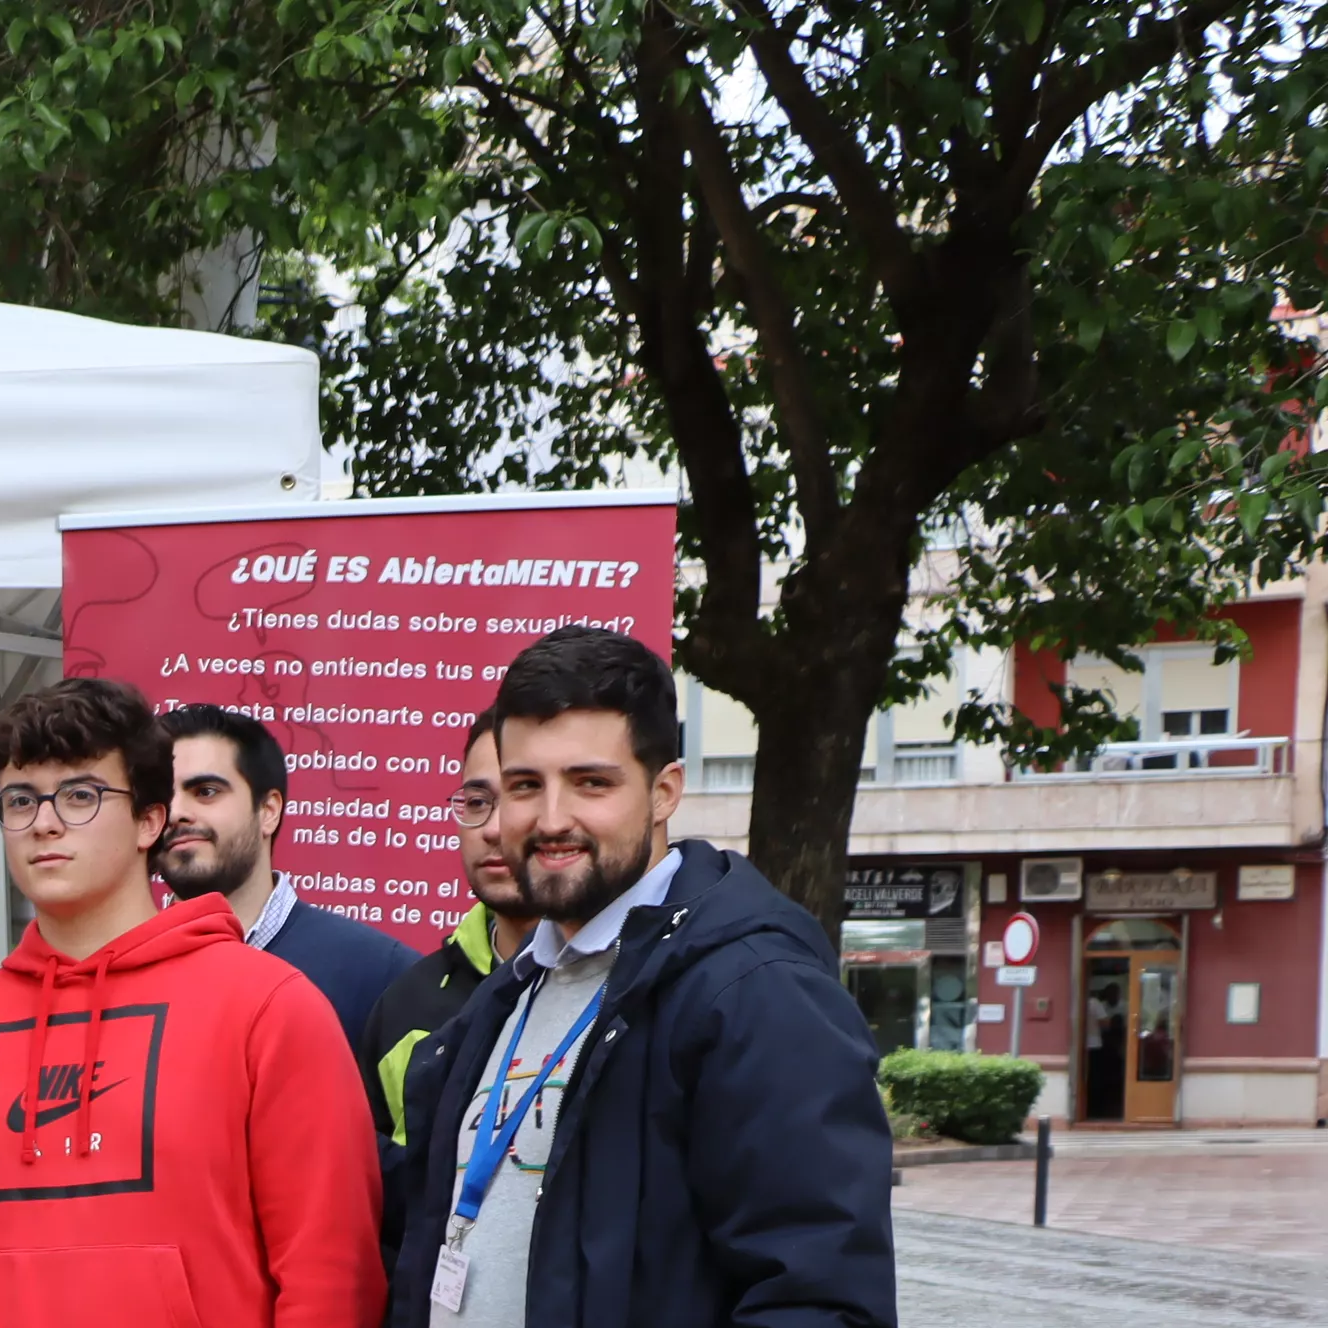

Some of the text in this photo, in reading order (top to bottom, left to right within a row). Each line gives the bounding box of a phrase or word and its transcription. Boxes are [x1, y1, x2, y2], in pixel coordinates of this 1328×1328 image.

[231, 549, 641, 588] ¿QUÉ ES AbiertaMENTE?
[227, 608, 319, 632] ¿Tienes
[327, 609, 400, 631] dudas
[408, 613, 477, 634] sobre
[160, 653, 190, 677] ¿A
[197, 658, 266, 676] veces
[274, 659, 303, 676] no
[312, 657, 427, 679] entiendes
[436, 661, 473, 681] tus
[284, 702, 424, 727] relacionarte
[431, 711, 476, 728] con
[385, 756, 431, 774] con
[439, 755, 462, 775] lo
[284, 798, 391, 819] ansiedad
[293, 825, 461, 854] más de lo que
[384, 879, 429, 897] con
[437, 879, 459, 898] el
[391, 904, 422, 924] de
[429, 909, 469, 930] qu
[37, 1061, 106, 1101] NIKE
